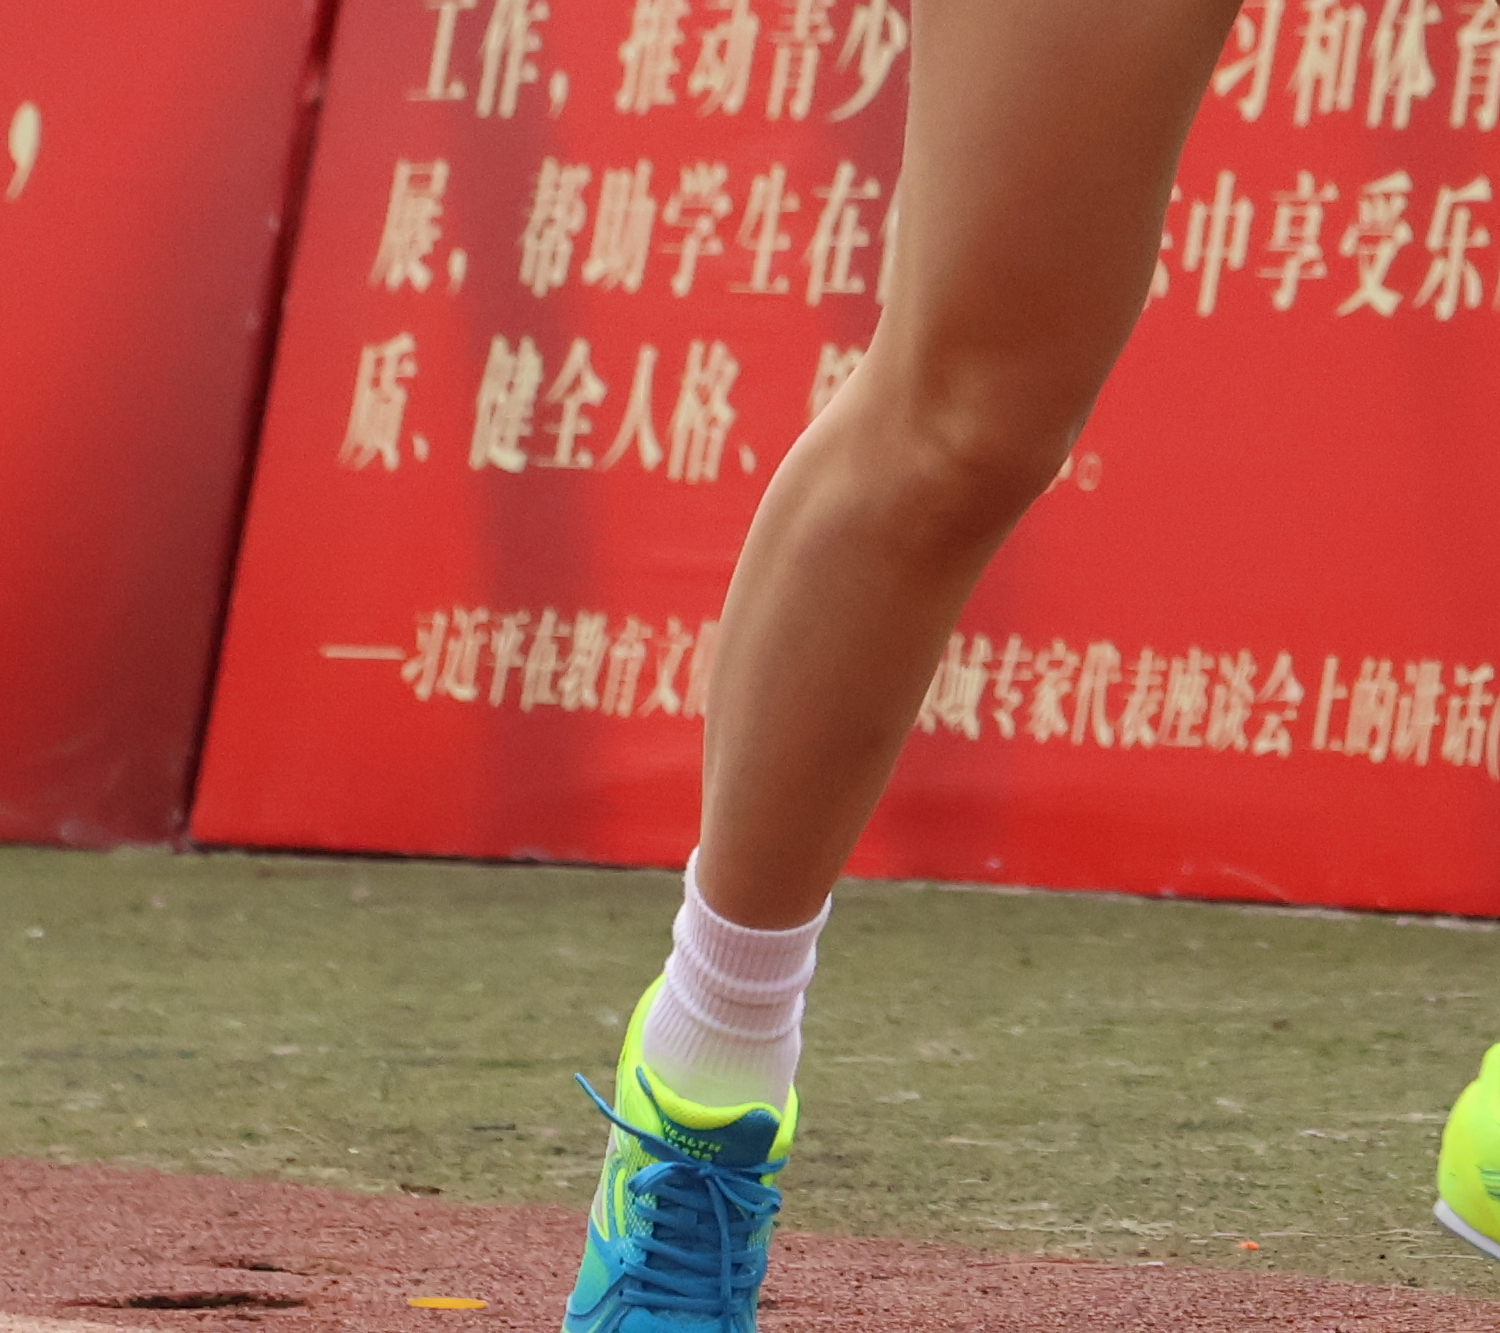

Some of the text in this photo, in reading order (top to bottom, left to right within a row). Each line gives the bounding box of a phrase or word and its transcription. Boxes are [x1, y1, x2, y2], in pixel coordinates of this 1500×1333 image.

[368, 156, 900, 311] 展,帮助学生在
